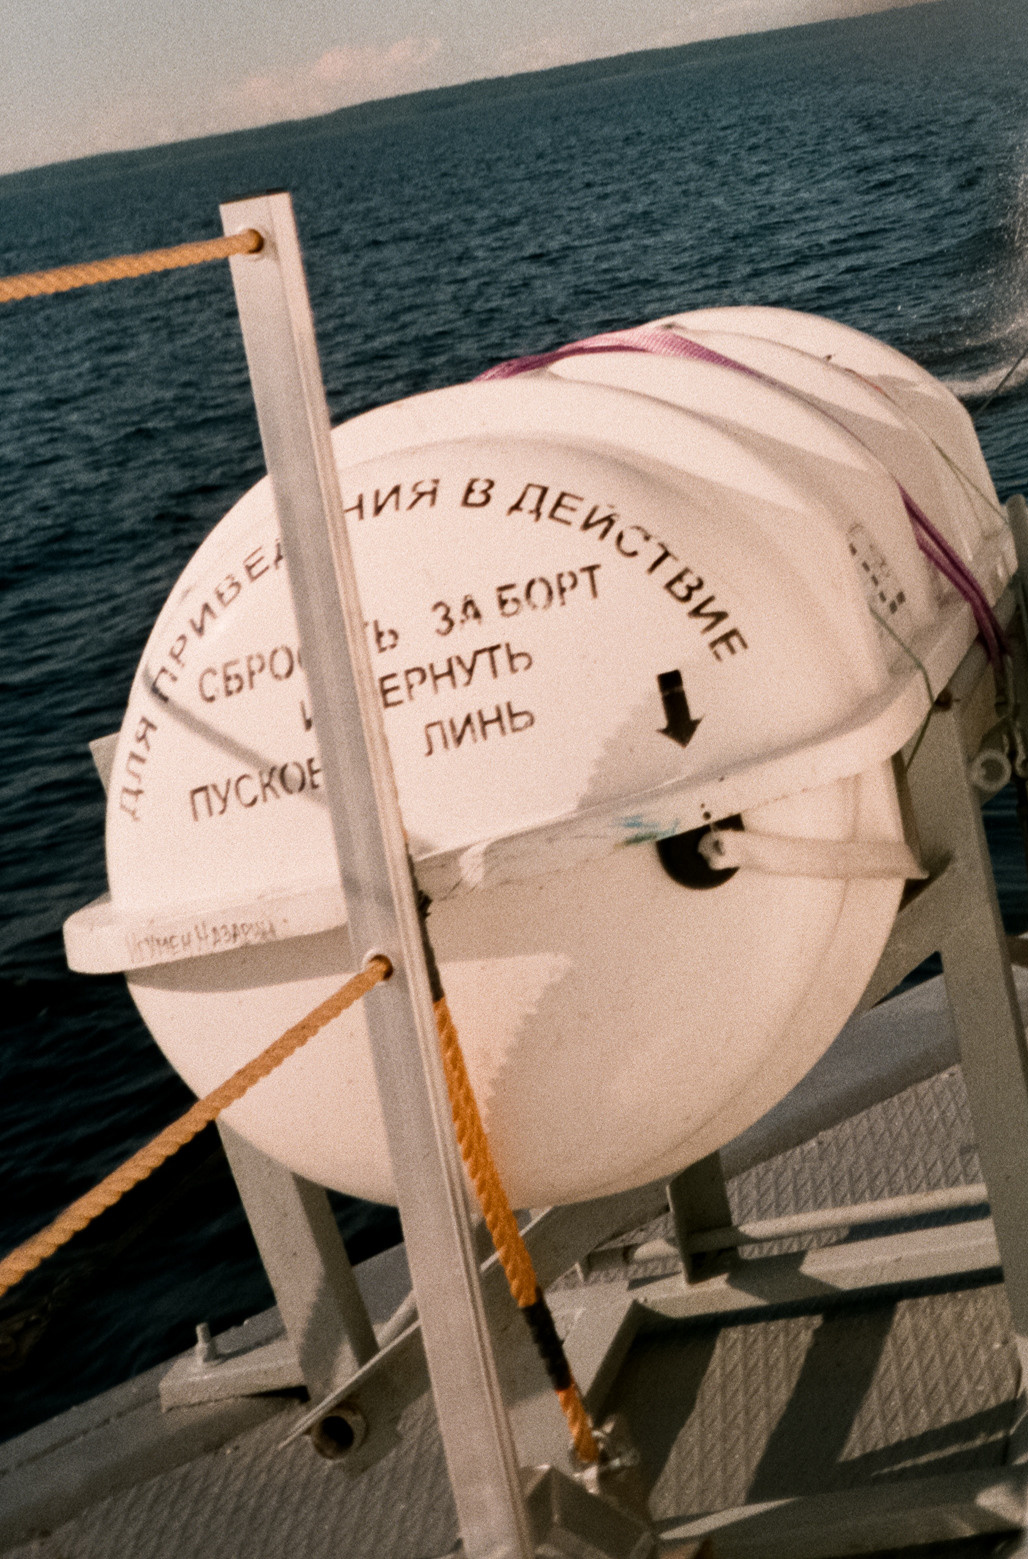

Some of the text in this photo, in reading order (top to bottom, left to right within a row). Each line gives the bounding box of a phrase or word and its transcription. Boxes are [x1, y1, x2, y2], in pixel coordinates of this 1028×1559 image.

[119, 477, 749, 823] ДЛЯ ПРИВЕНИЯ В ДЕЙСТВИЕ
[198, 563, 602, 704] СБРОЬ ЗА БОРТ
[377, 642, 533, 710] ЕРНУТЬ
[189, 701, 535, 823] ПУСКОВ ЛИНЬ
